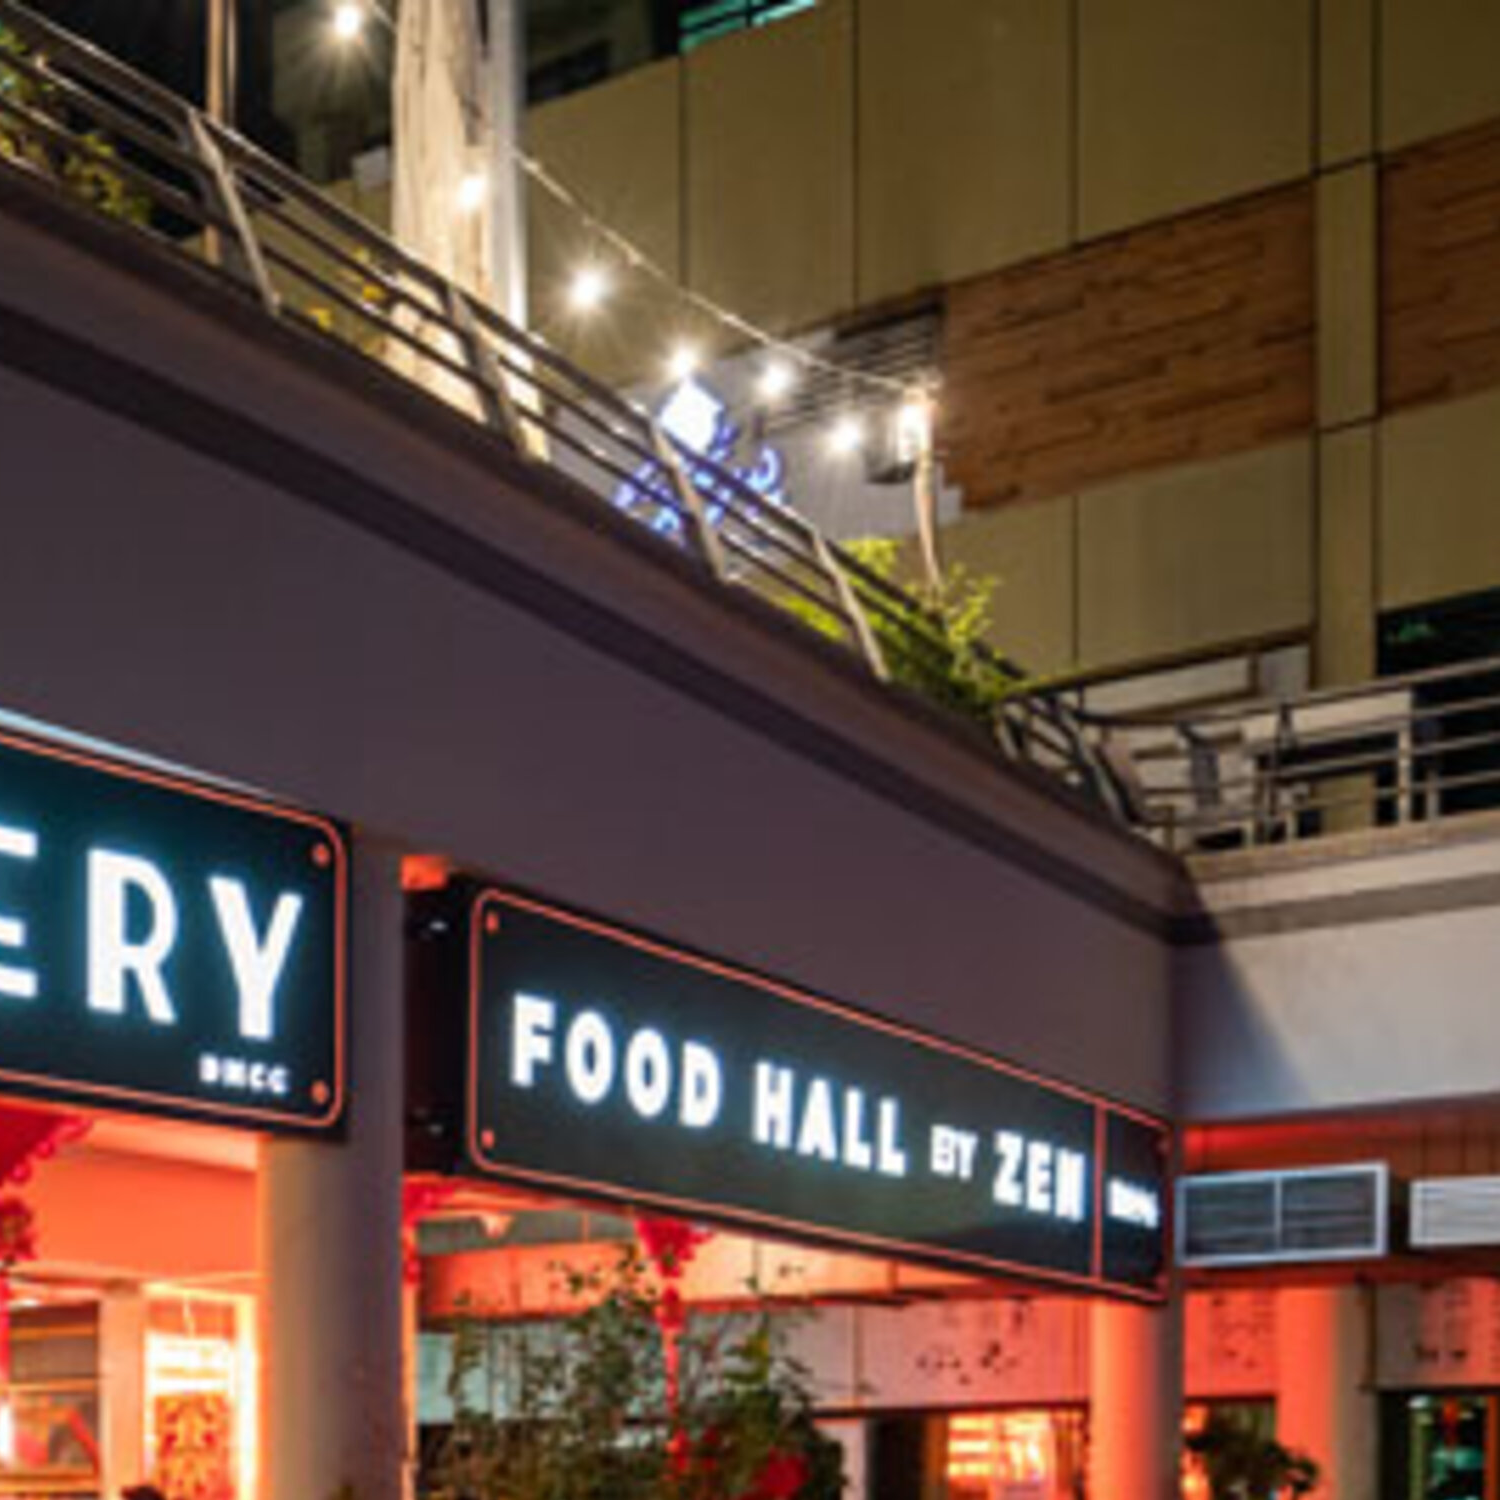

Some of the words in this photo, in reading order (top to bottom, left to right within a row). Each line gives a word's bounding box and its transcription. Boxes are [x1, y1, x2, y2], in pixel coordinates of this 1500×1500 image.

[510, 992, 723, 1129] FOOD
[751, 1060, 908, 1178] HALL
[928, 1123, 979, 1181] BY
[991, 1129, 1086, 1222] ZEN
